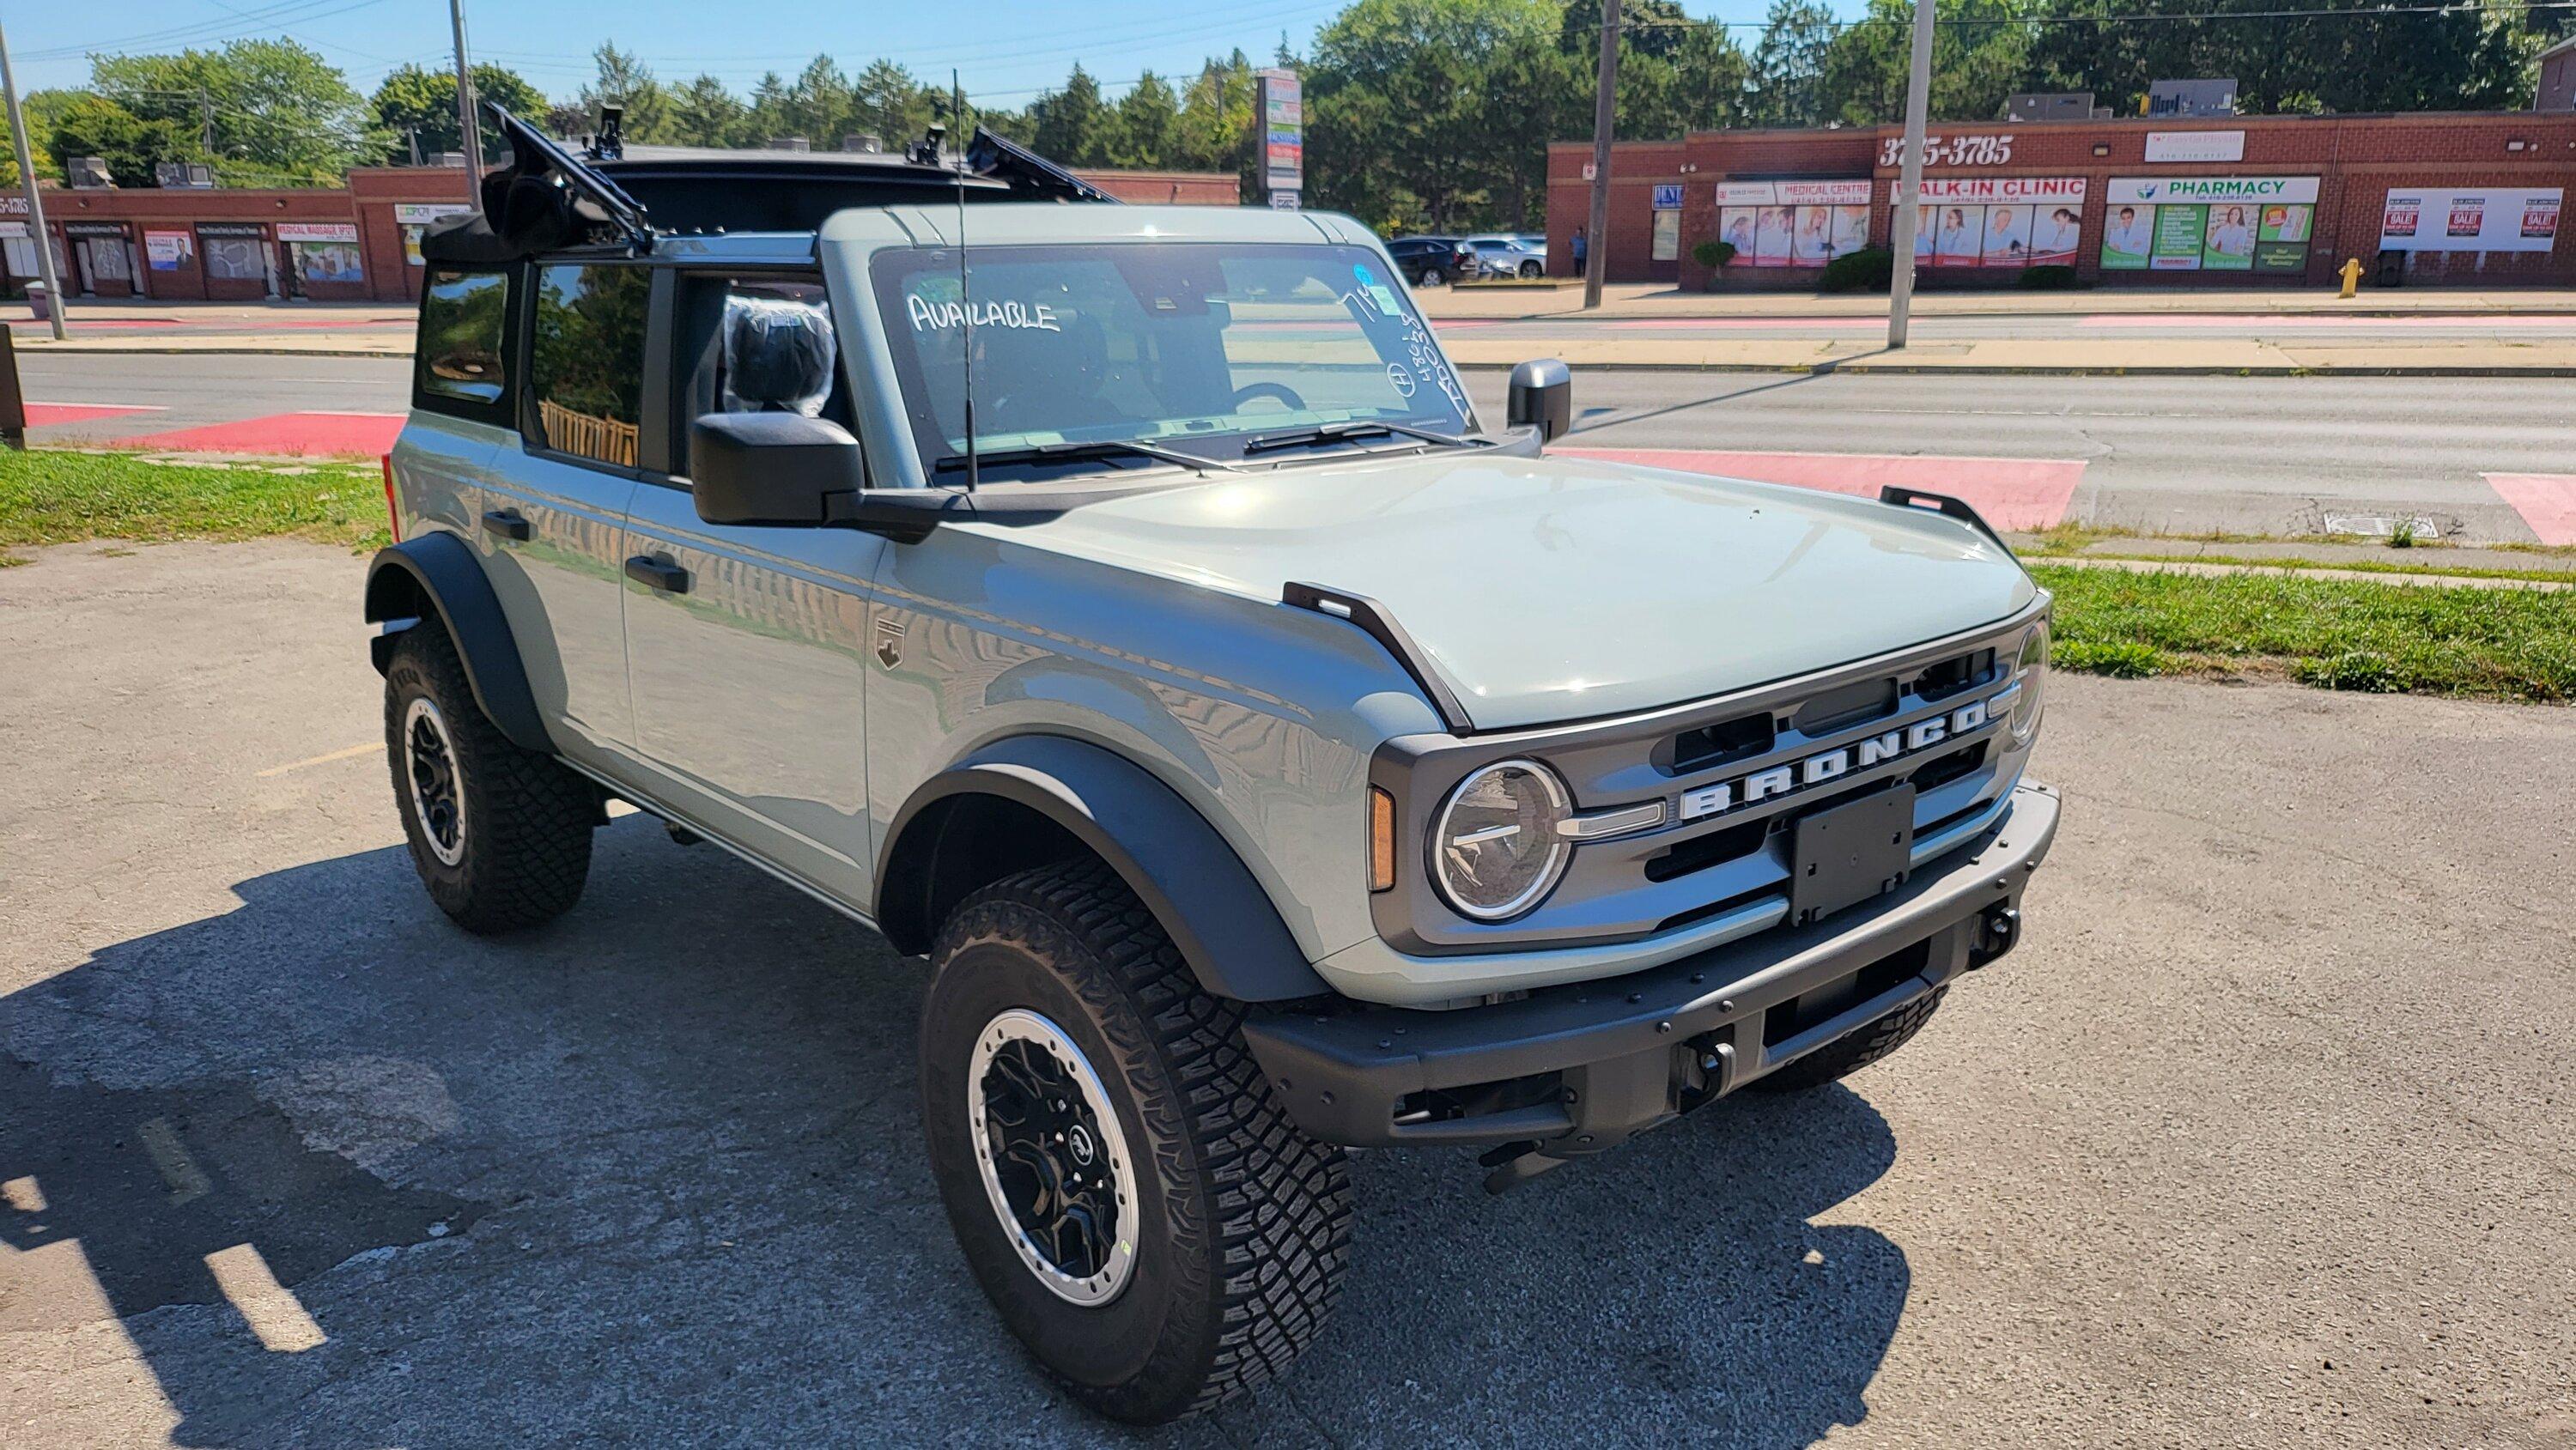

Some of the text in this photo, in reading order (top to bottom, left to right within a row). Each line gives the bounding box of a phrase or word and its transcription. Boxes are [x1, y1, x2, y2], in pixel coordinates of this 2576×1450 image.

[1880, 136, 2014, 166] 35-3785
[1785, 183, 1869, 195] MEDICAL CENTRE
[1897, 179, 2083, 196] ALK-IN CLINIC
[2169, 181, 2286, 196] PHARMACY
[907, 292, 1061, 332] AVAILABLE
[1680, 701, 1989, 821] BRONCO
